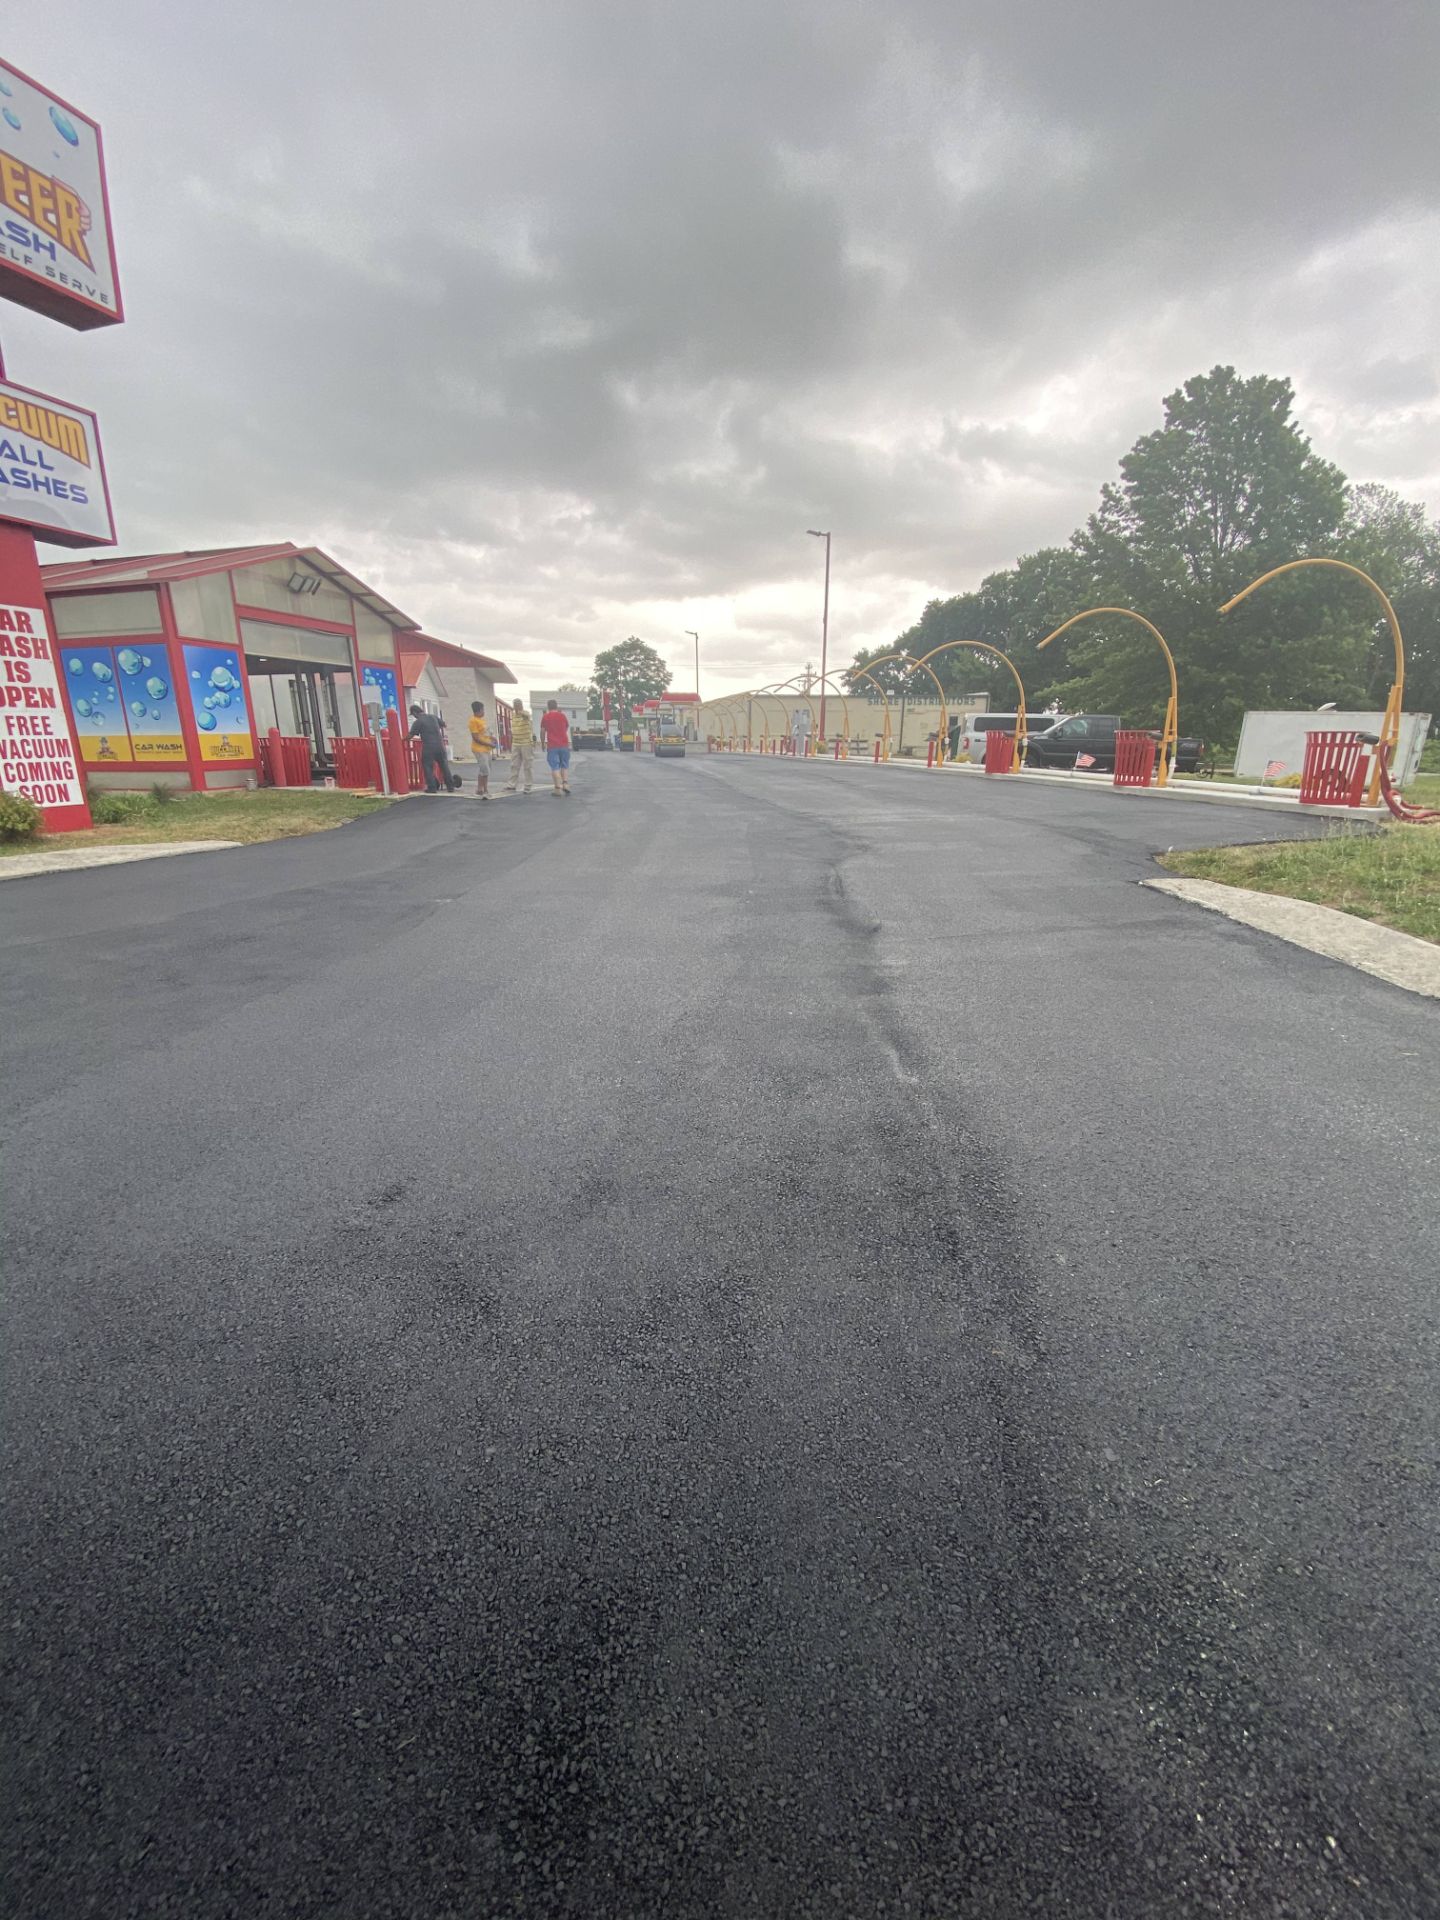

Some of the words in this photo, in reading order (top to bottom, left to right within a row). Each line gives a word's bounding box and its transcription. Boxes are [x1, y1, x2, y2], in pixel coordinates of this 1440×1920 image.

[0, 221, 56, 262] SH
[45, 265, 109, 305] SERVE
[0, 440, 54, 471] ALL
[0, 609, 34, 634] AR
[4, 660, 31, 684] IS
[867, 696, 899, 706] SHORE
[5, 715, 54, 736] FREE
[4, 761, 74, 783] COMING
[19, 784, 71, 805] SOON
